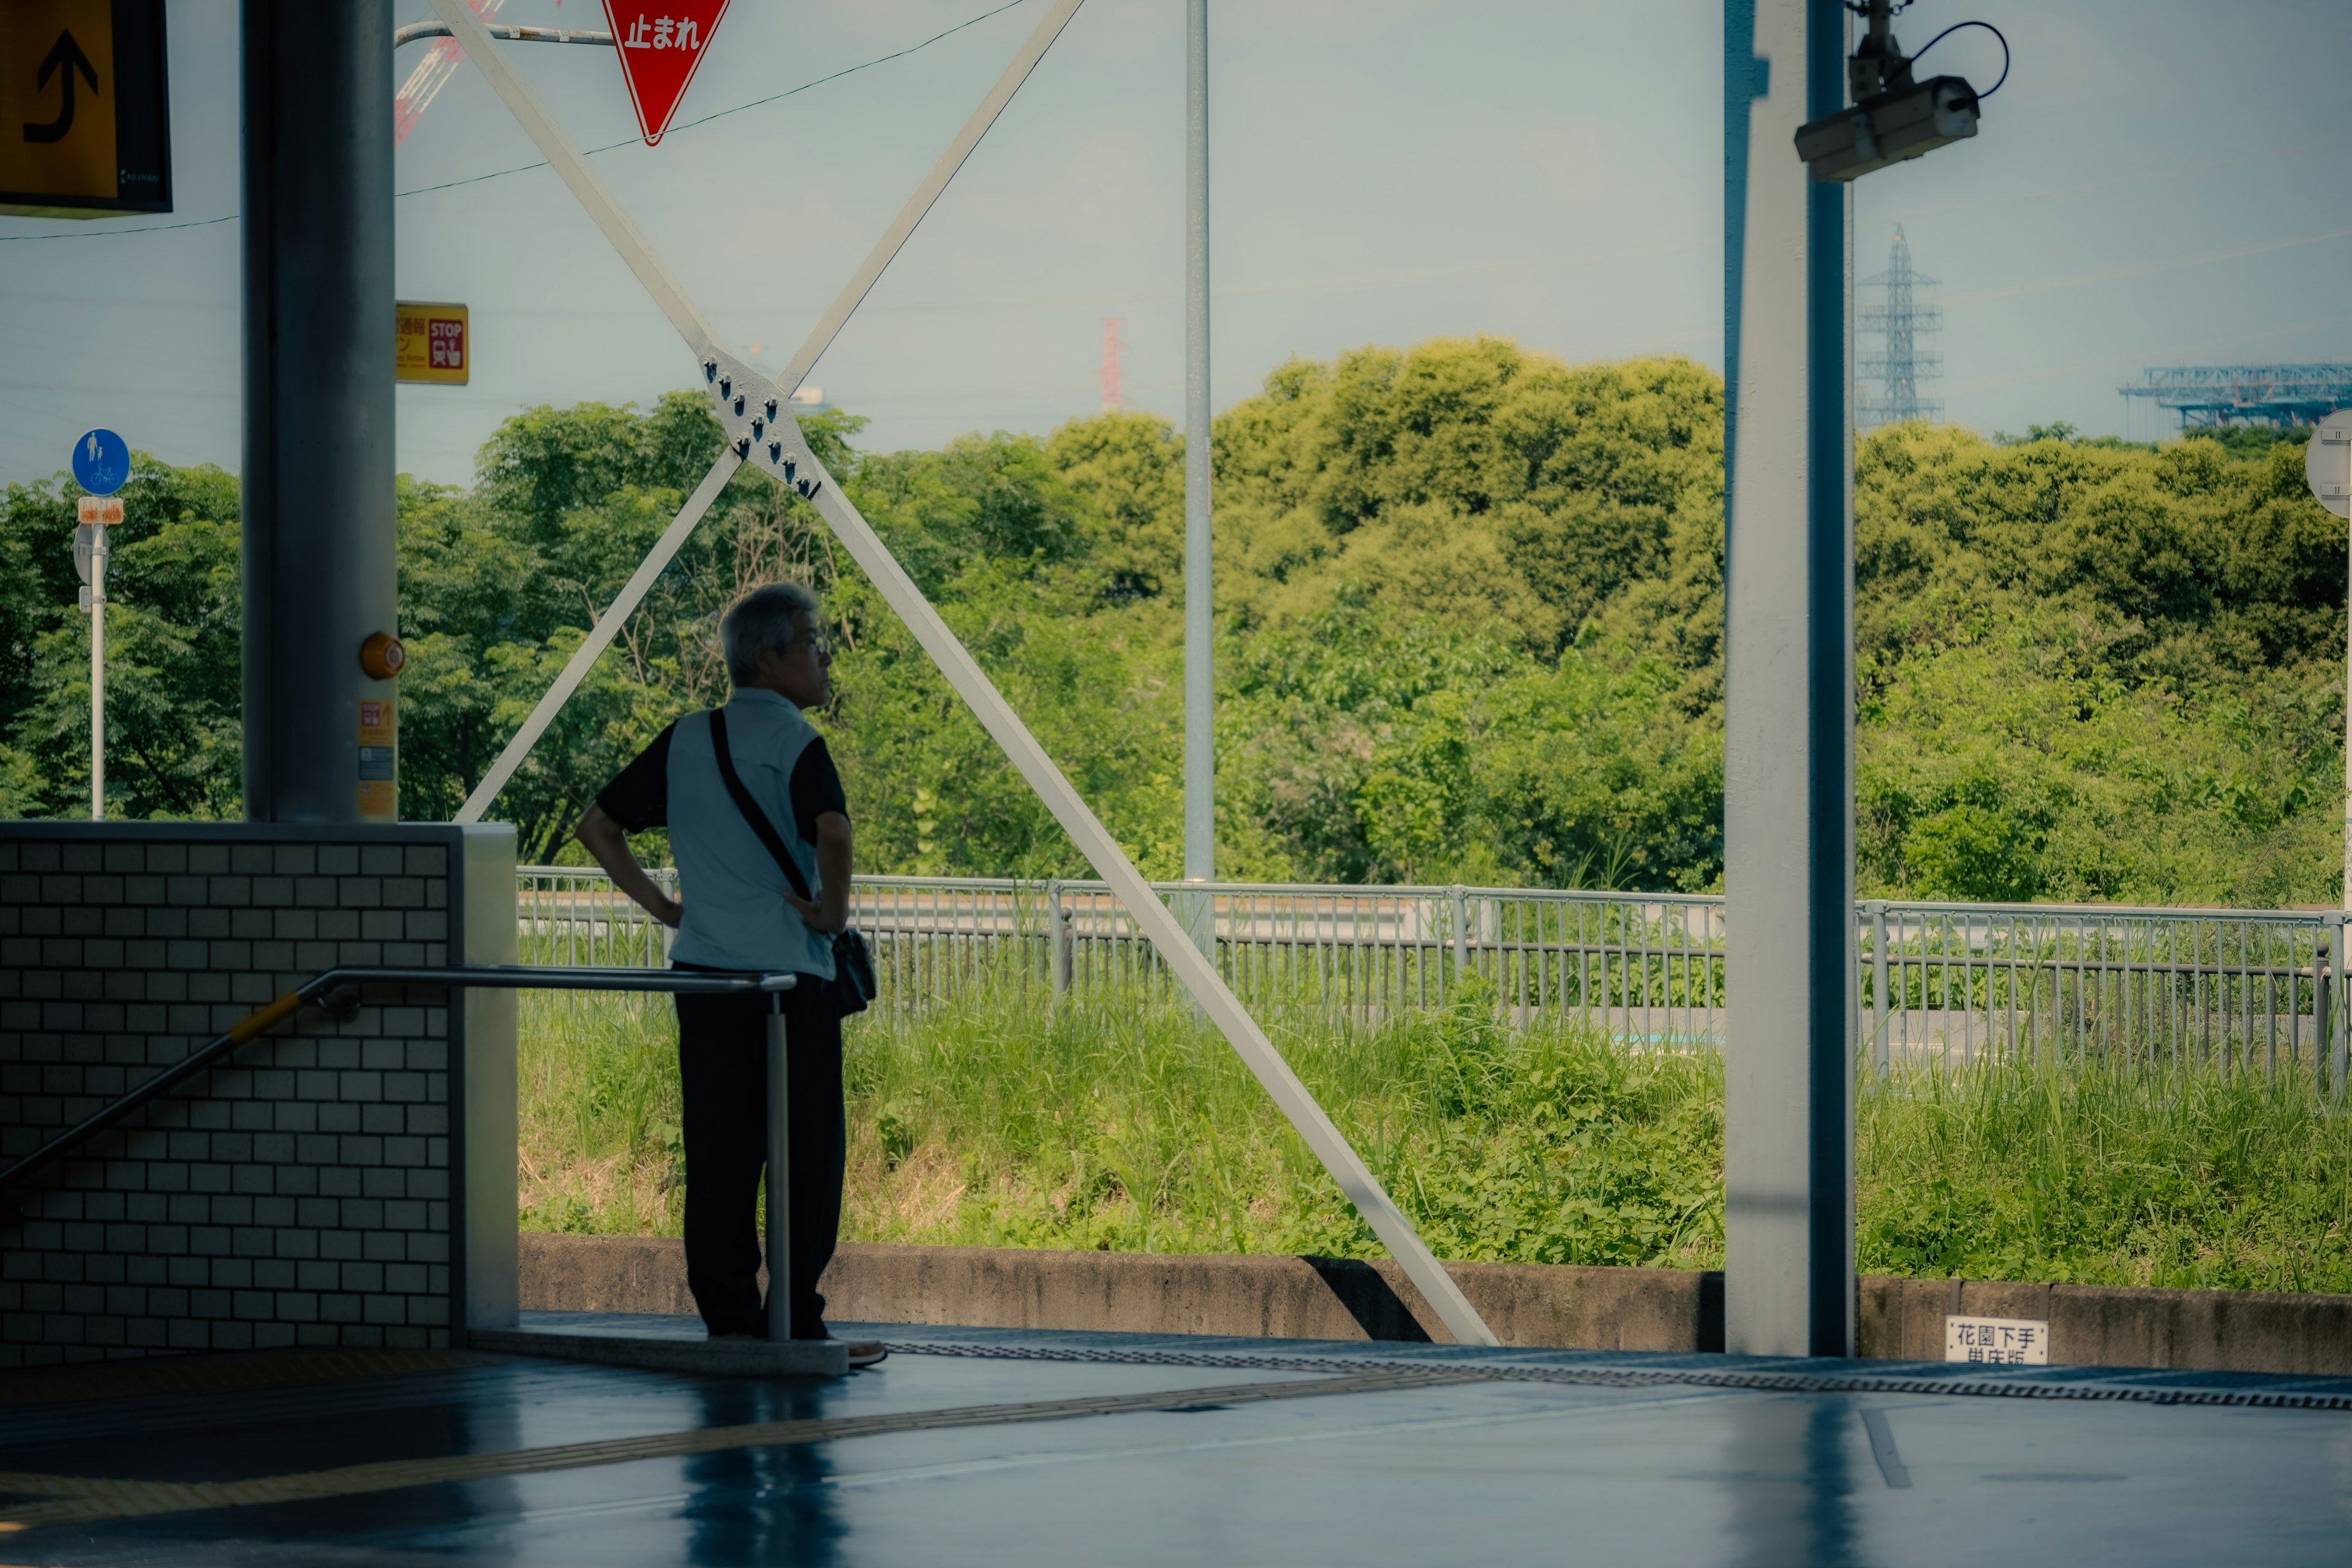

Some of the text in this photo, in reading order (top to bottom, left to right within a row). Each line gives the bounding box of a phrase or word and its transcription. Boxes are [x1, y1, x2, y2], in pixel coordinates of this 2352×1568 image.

[624, 13, 700, 51] 止まれ
[396, 317, 426, 335] 通報
[431, 322, 462, 337] STOP
[1958, 1324, 2035, 1349] 花園下手
